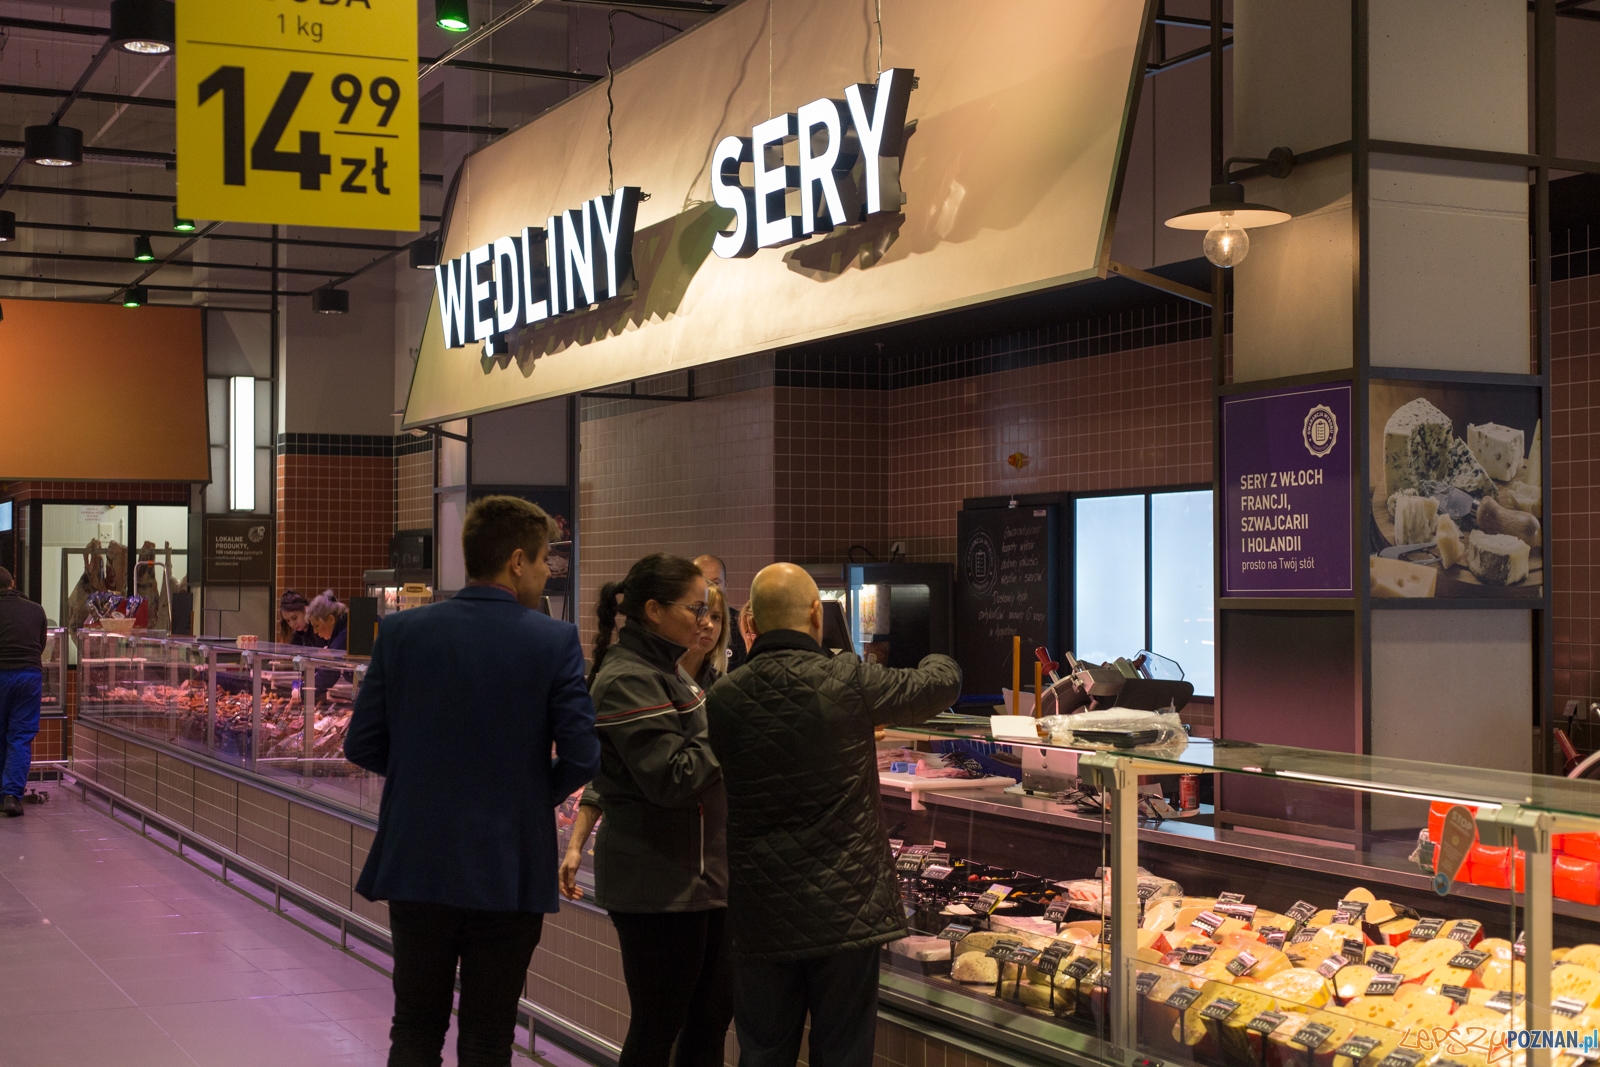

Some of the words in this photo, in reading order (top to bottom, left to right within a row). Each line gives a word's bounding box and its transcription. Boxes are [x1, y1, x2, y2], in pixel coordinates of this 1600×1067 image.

[278, 14, 286, 34] 1
[297, 15, 323, 43] kg
[197, 65, 332, 190] 14
[330, 73, 401, 128] 99
[340, 147, 391, 196] zł
[435, 187, 632, 358] WĘDLINY
[711, 69, 906, 258] SERY
[1240, 473, 1268, 491] SERY
[1270, 472, 1277, 488] Z
[1279, 469, 1323, 487] WŁOCH
[1241, 492, 1292, 512] FRANCJI,
[1241, 513, 1309, 532] SZWAJCARII
[1241, 538, 1245, 553] I
[1248, 535, 1302, 553] HOLANDII
[1242, 558, 1266, 574] prosto
[1267, 559, 1278, 571] na
[1279, 557, 1298, 573] Twój
[1299, 556, 1315, 569] stół
[1452, 810, 1473, 831] STOP
